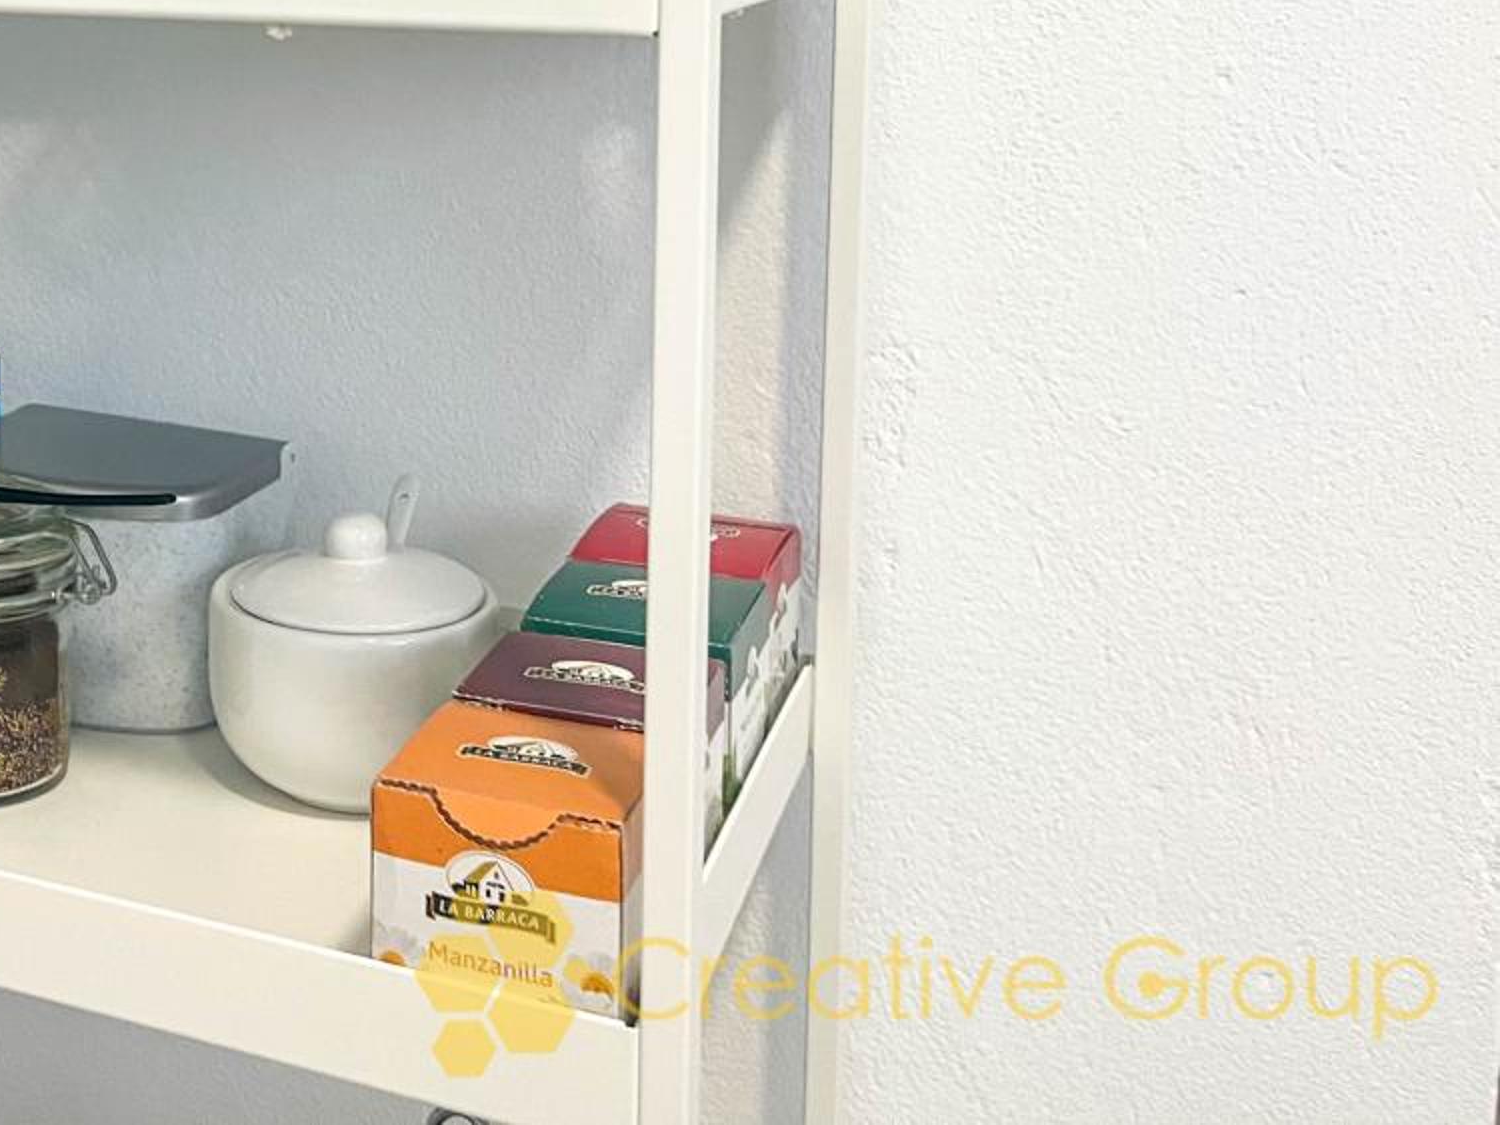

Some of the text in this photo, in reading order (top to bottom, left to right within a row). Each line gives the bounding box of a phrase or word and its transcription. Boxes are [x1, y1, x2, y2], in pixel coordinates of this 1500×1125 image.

[438, 899, 540, 930] LA BARRACA
[428, 940, 554, 988] Manzanilla
